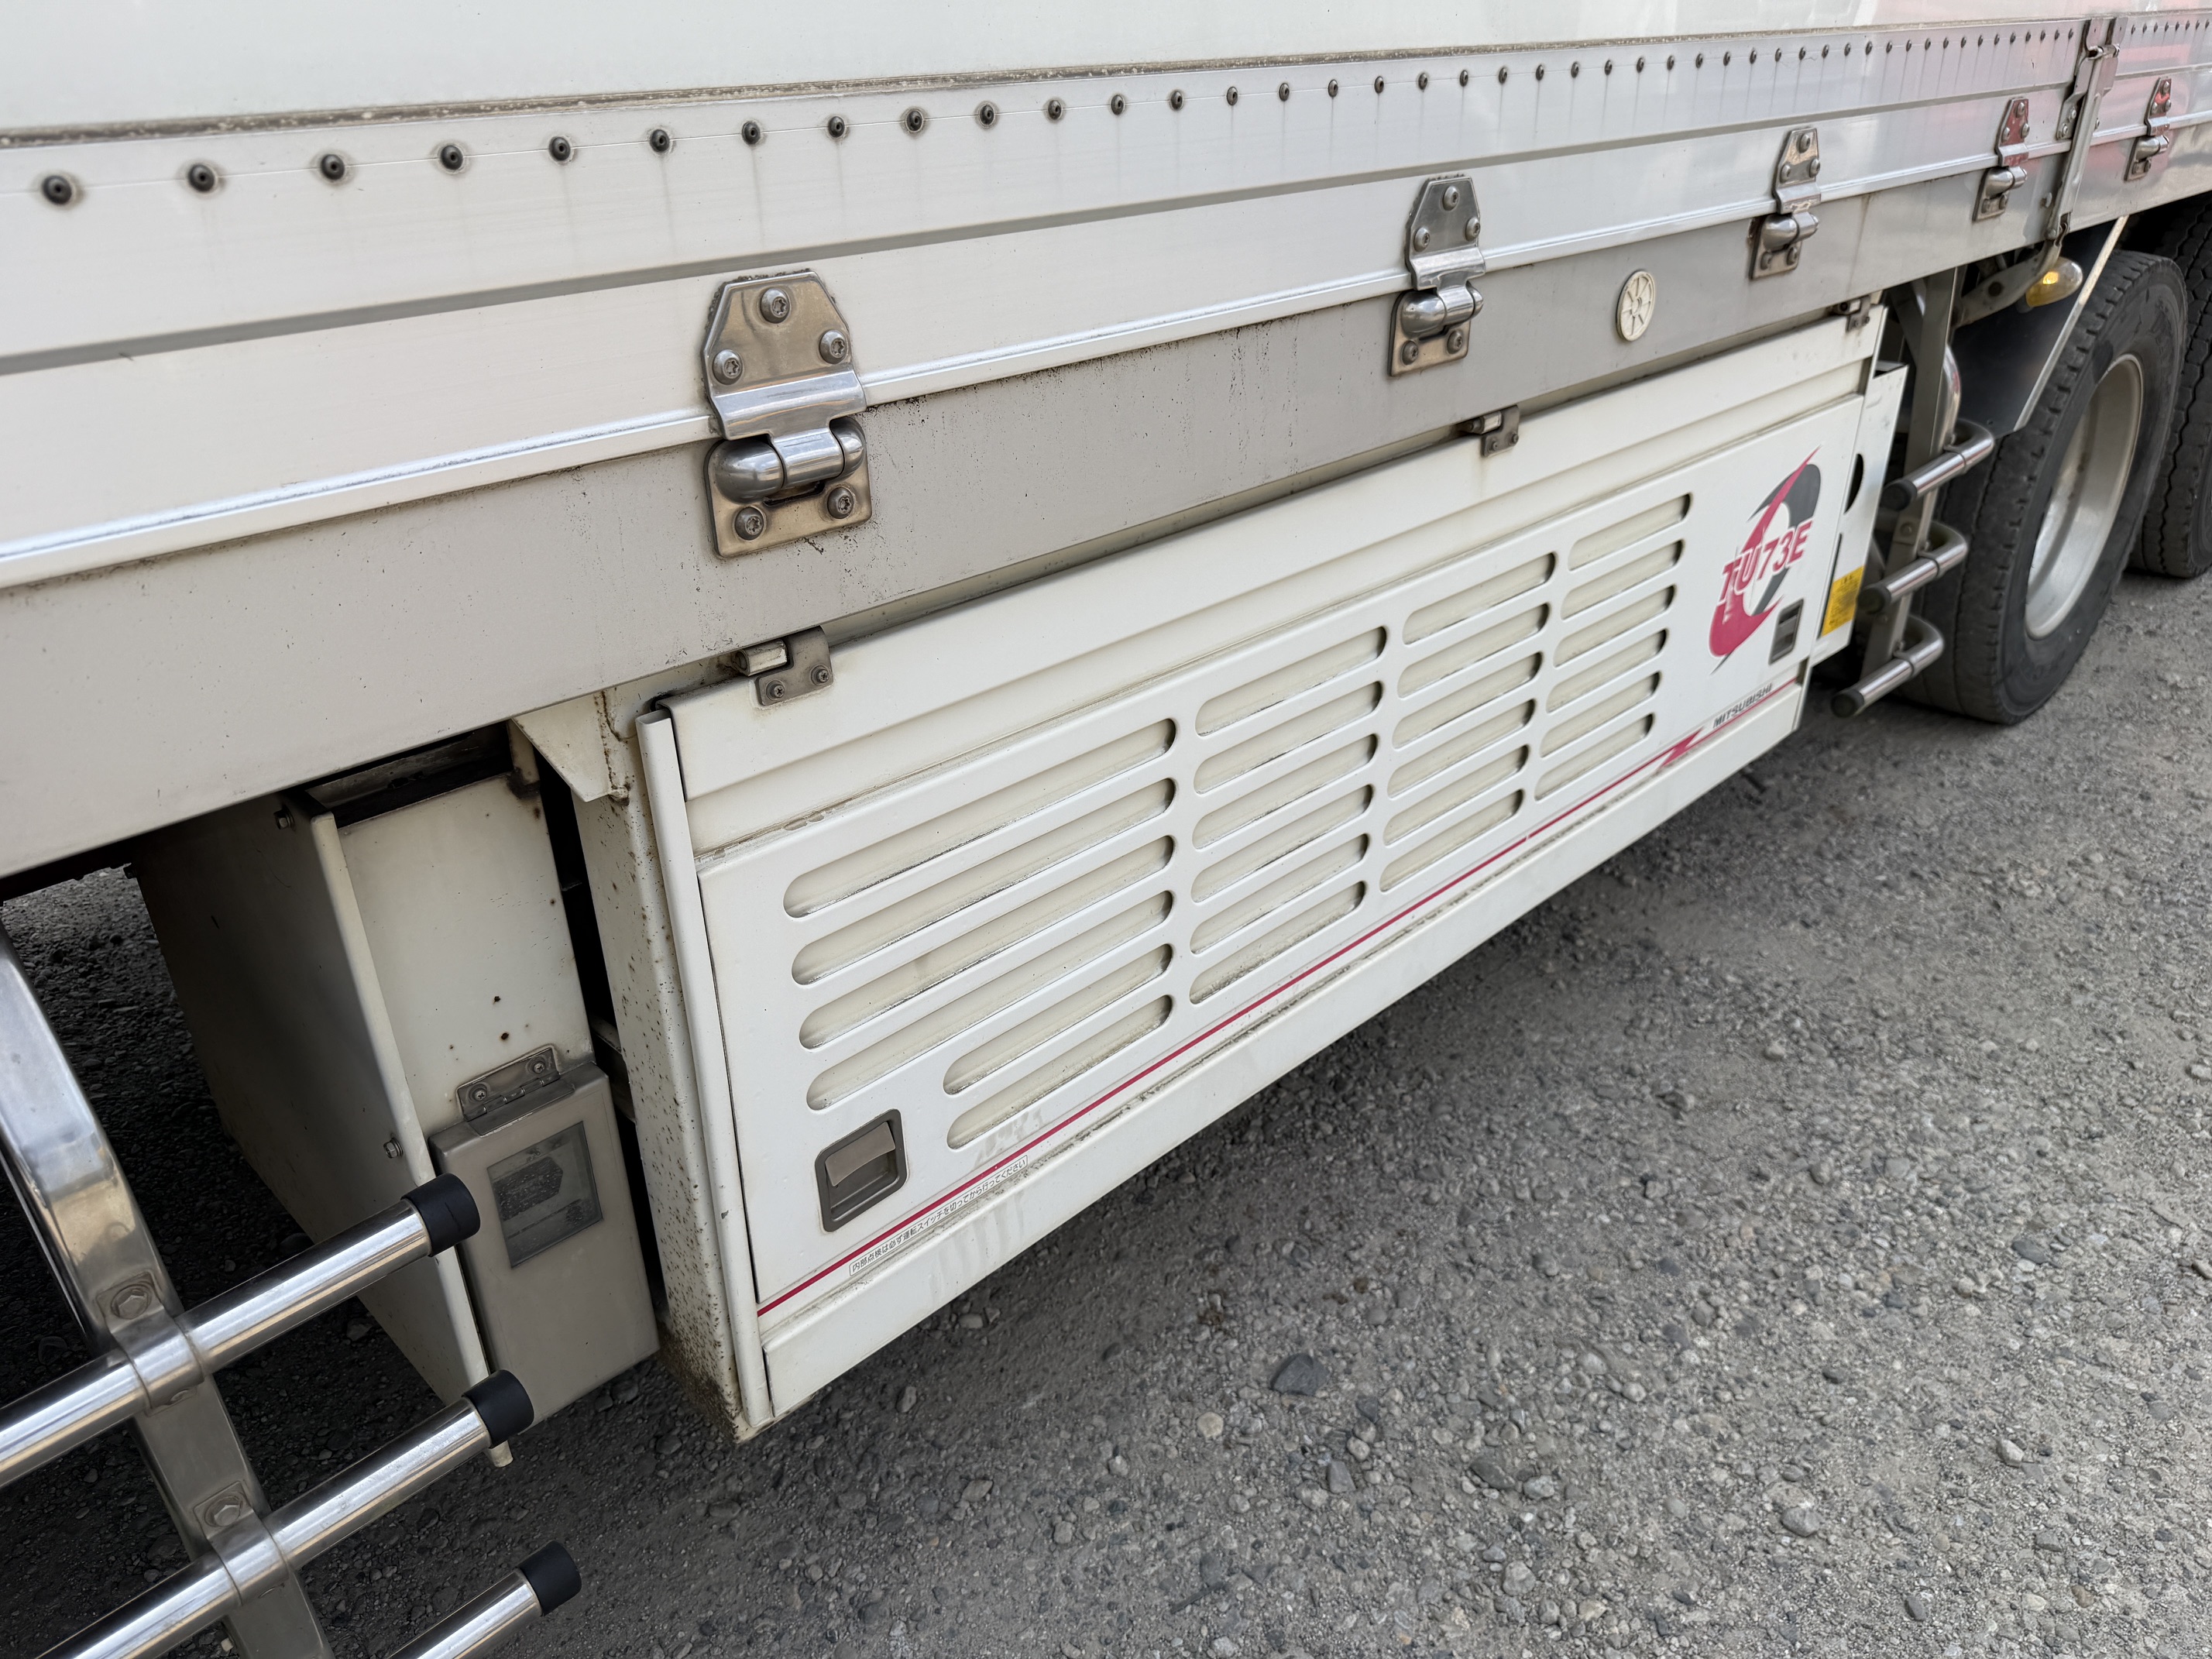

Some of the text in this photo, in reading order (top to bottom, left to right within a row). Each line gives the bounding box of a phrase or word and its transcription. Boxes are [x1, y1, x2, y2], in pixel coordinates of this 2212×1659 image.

[1719, 520, 1813, 603] TU73E
[1712, 682, 1772, 728] MITSUBISHI
[852, 1159, 1025, 1273] 内部点検は必ず運転スイッチを切ってから行ってください
